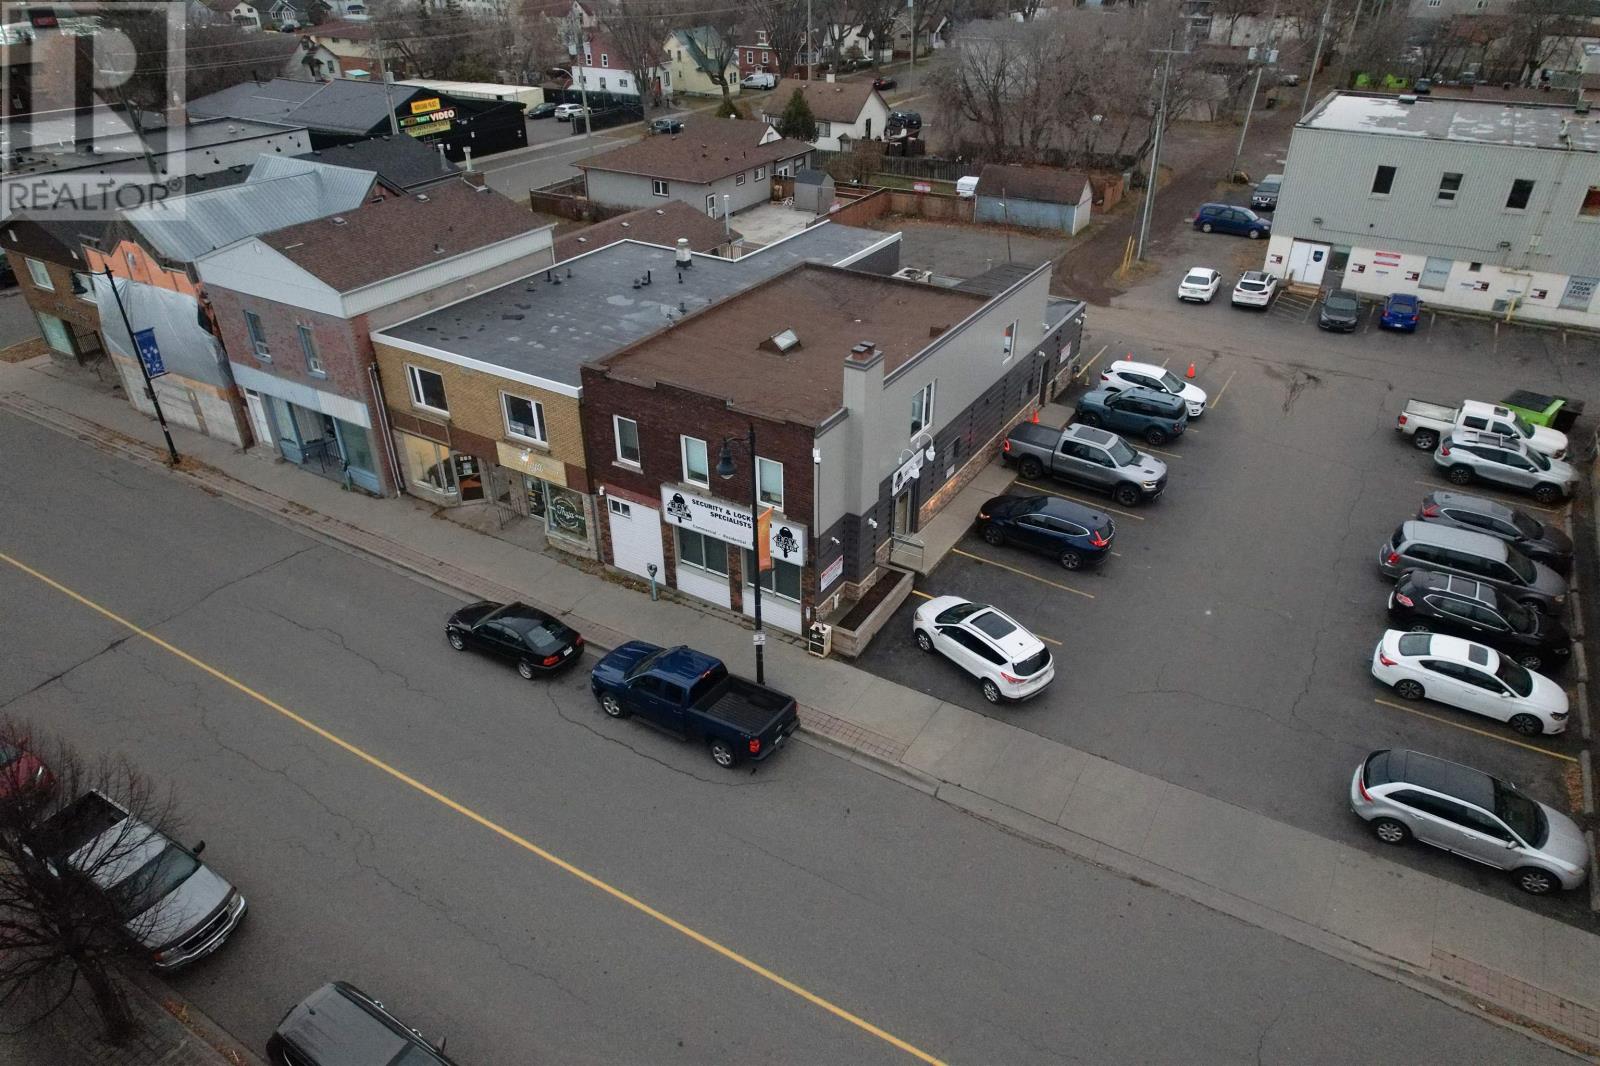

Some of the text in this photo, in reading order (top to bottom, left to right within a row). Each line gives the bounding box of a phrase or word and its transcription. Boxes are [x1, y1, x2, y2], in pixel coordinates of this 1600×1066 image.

[430, 109, 455, 122] VIDEO
[670, 501, 688, 512] BAY
[691, 499, 723, 513] SECURITY
[725, 508, 732, 516] &
[709, 511, 753, 529] SPECIALISTS
[776, 533, 797, 547] BAY
